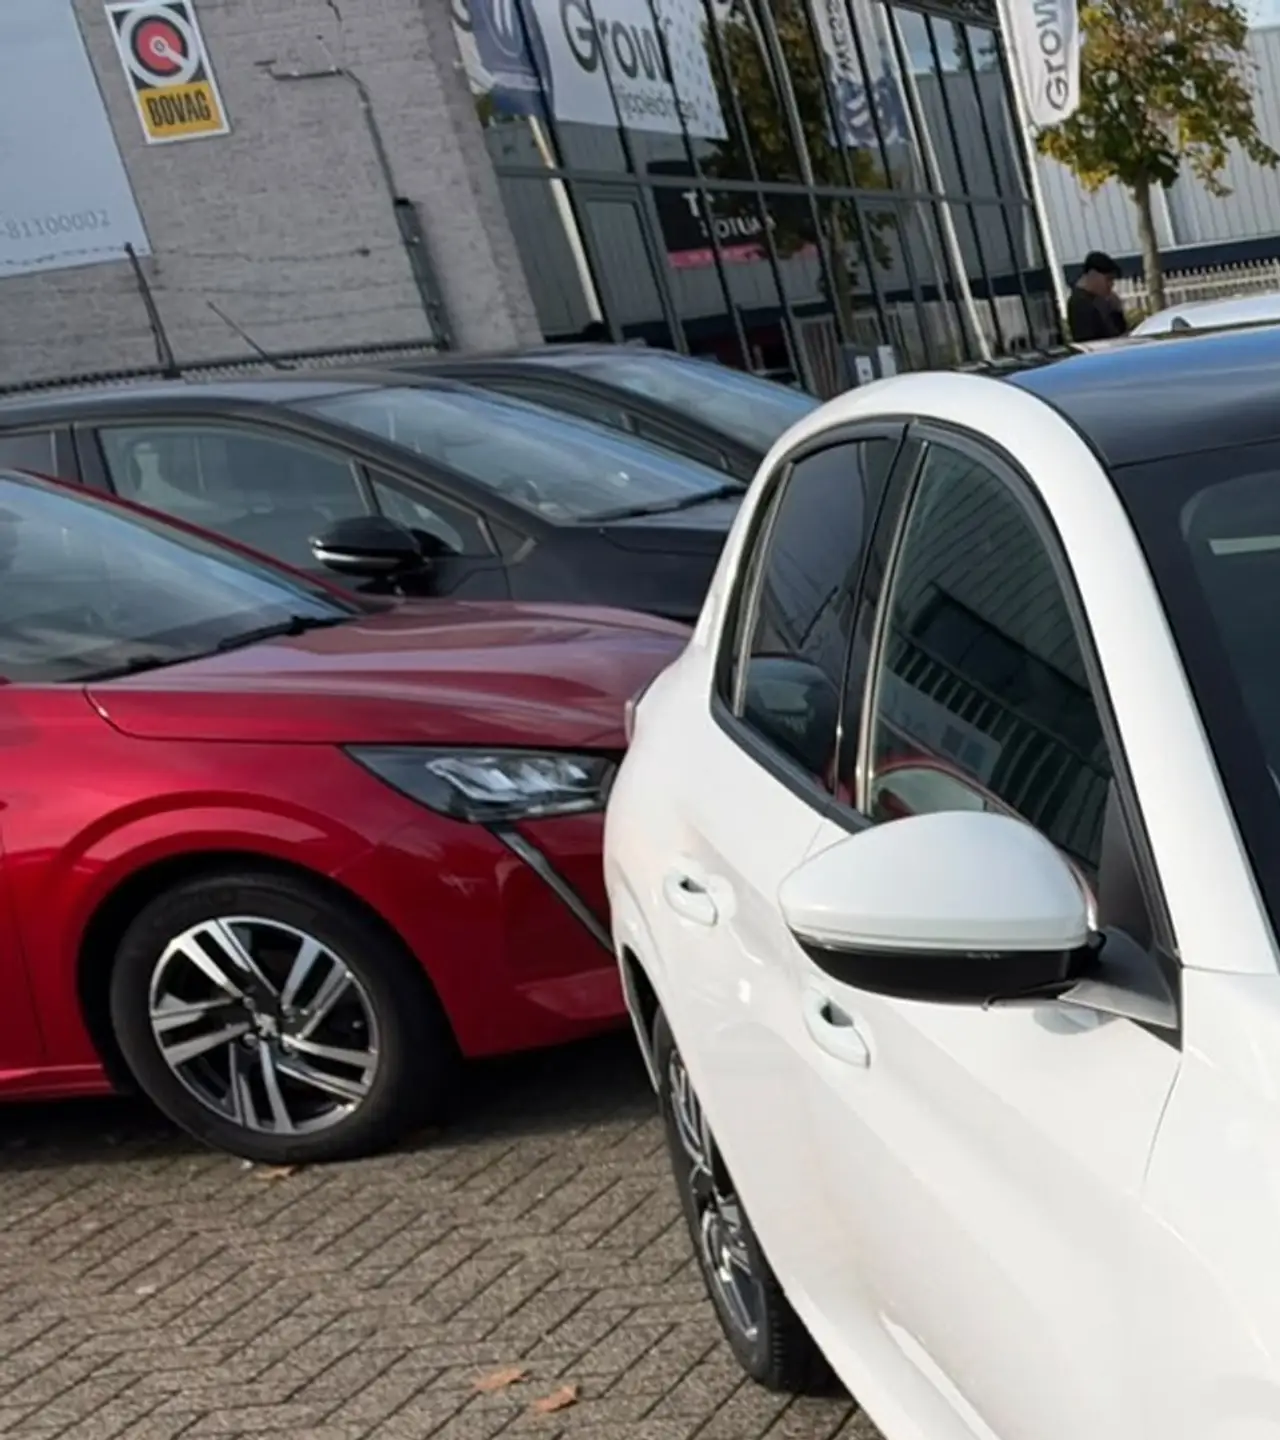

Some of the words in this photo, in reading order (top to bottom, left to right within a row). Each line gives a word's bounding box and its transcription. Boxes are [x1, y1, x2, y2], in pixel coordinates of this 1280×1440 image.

[559, 0, 674, 83] Grow
[1033, 0, 1069, 111] Grow
[145, 88, 212, 128] BOVAG
